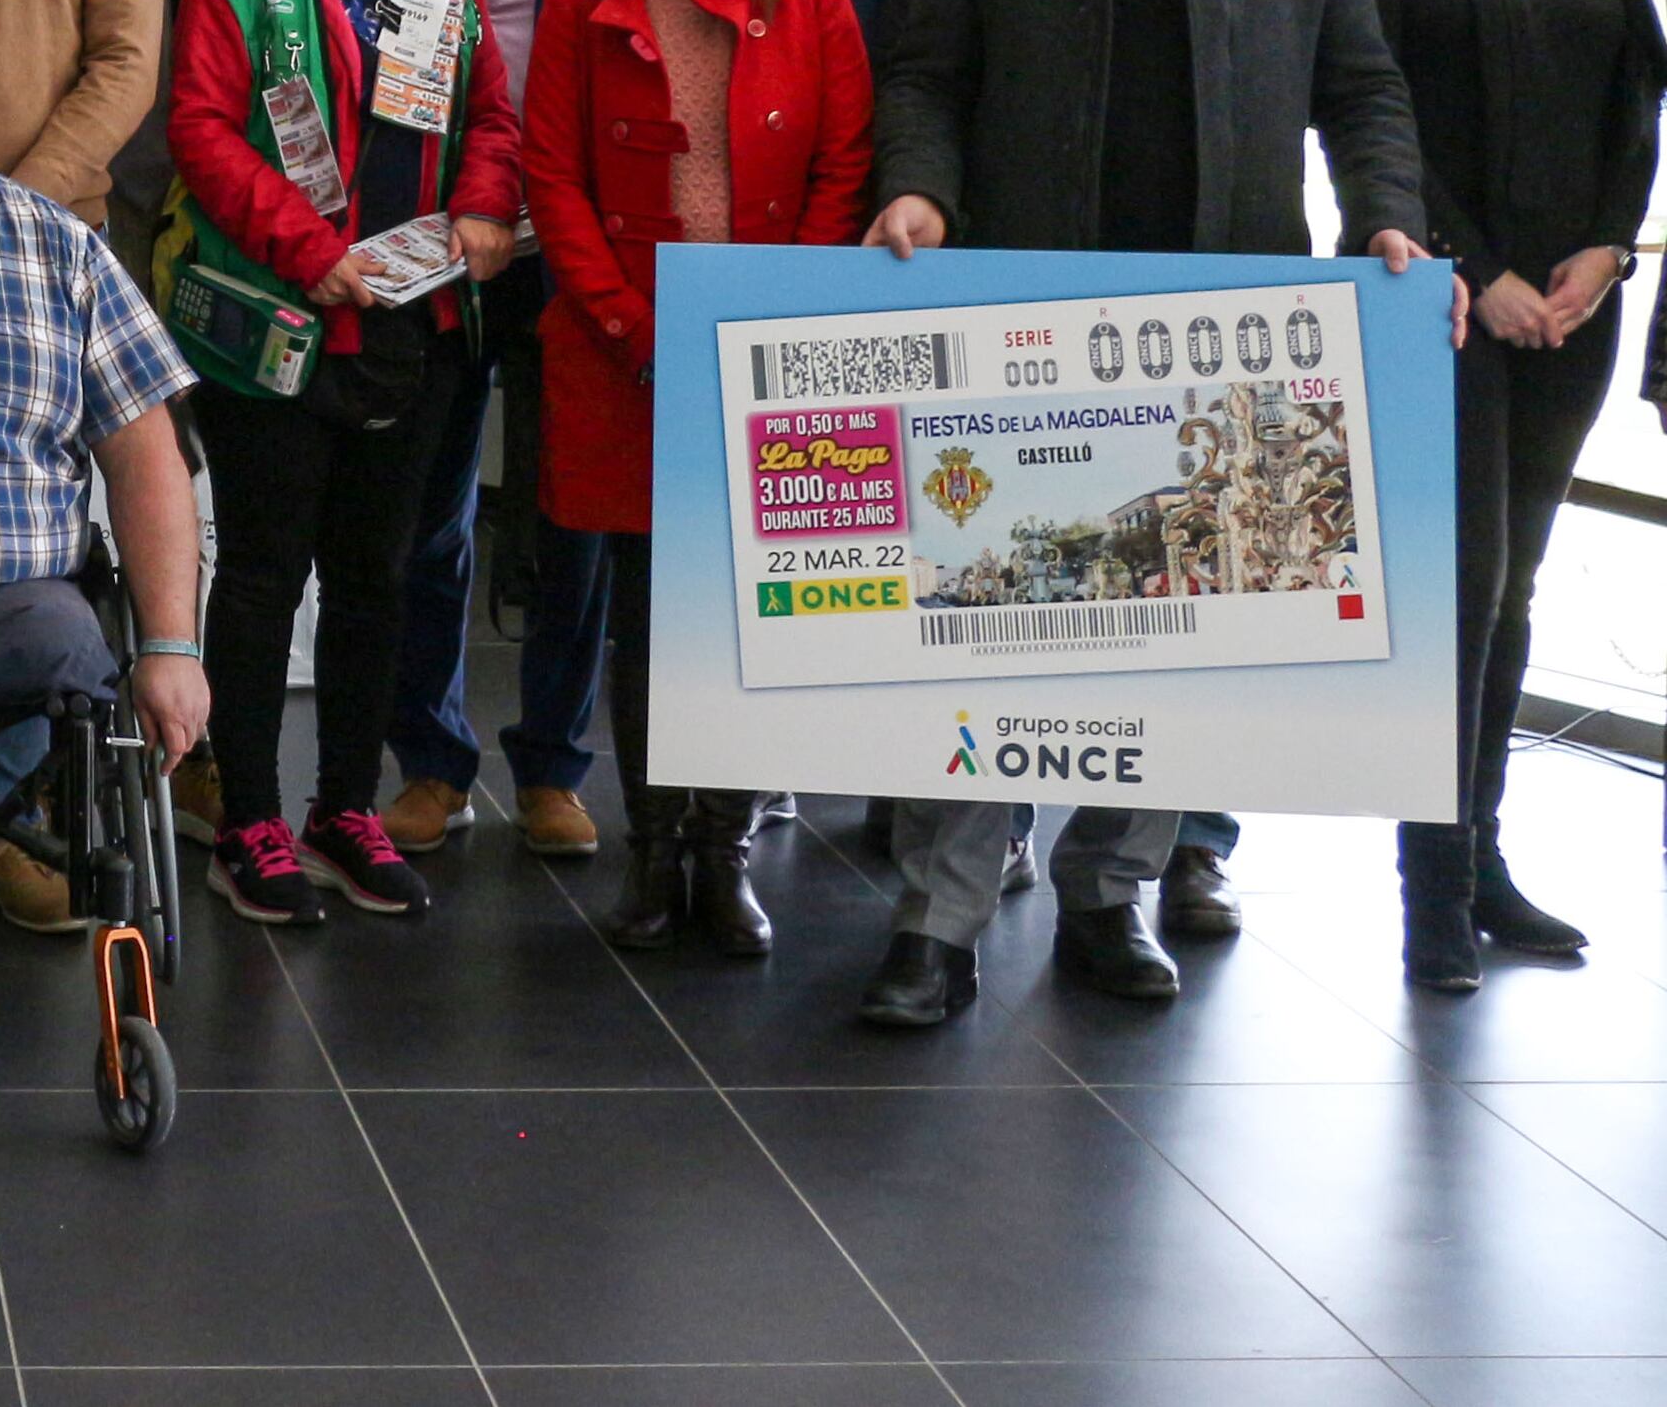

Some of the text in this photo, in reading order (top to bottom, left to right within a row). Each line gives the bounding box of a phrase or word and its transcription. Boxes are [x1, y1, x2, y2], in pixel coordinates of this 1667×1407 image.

[1004, 329, 1052, 347] SERIE
[1004, 358, 1058, 387] 000
[1289, 378, 1342, 401] 1,50 €
[767, 410, 876, 436] POR 0,50 € MÁS
[911, 404, 1176, 439] FIESTAS DE LA MAGDALENA
[757, 438, 891, 474] La Paga
[1017, 442, 1092, 466] CASTELLÓ
[759, 474, 893, 505] 3.000 € AL MES
[762, 504, 895, 531] DURANTE 25 AÑOS
[768, 545, 905, 573] 22 MAR. 22
[800, 581, 900, 610] ONCE
[996, 715, 1144, 739] grupo social
[995, 742, 1143, 784] ONCE
